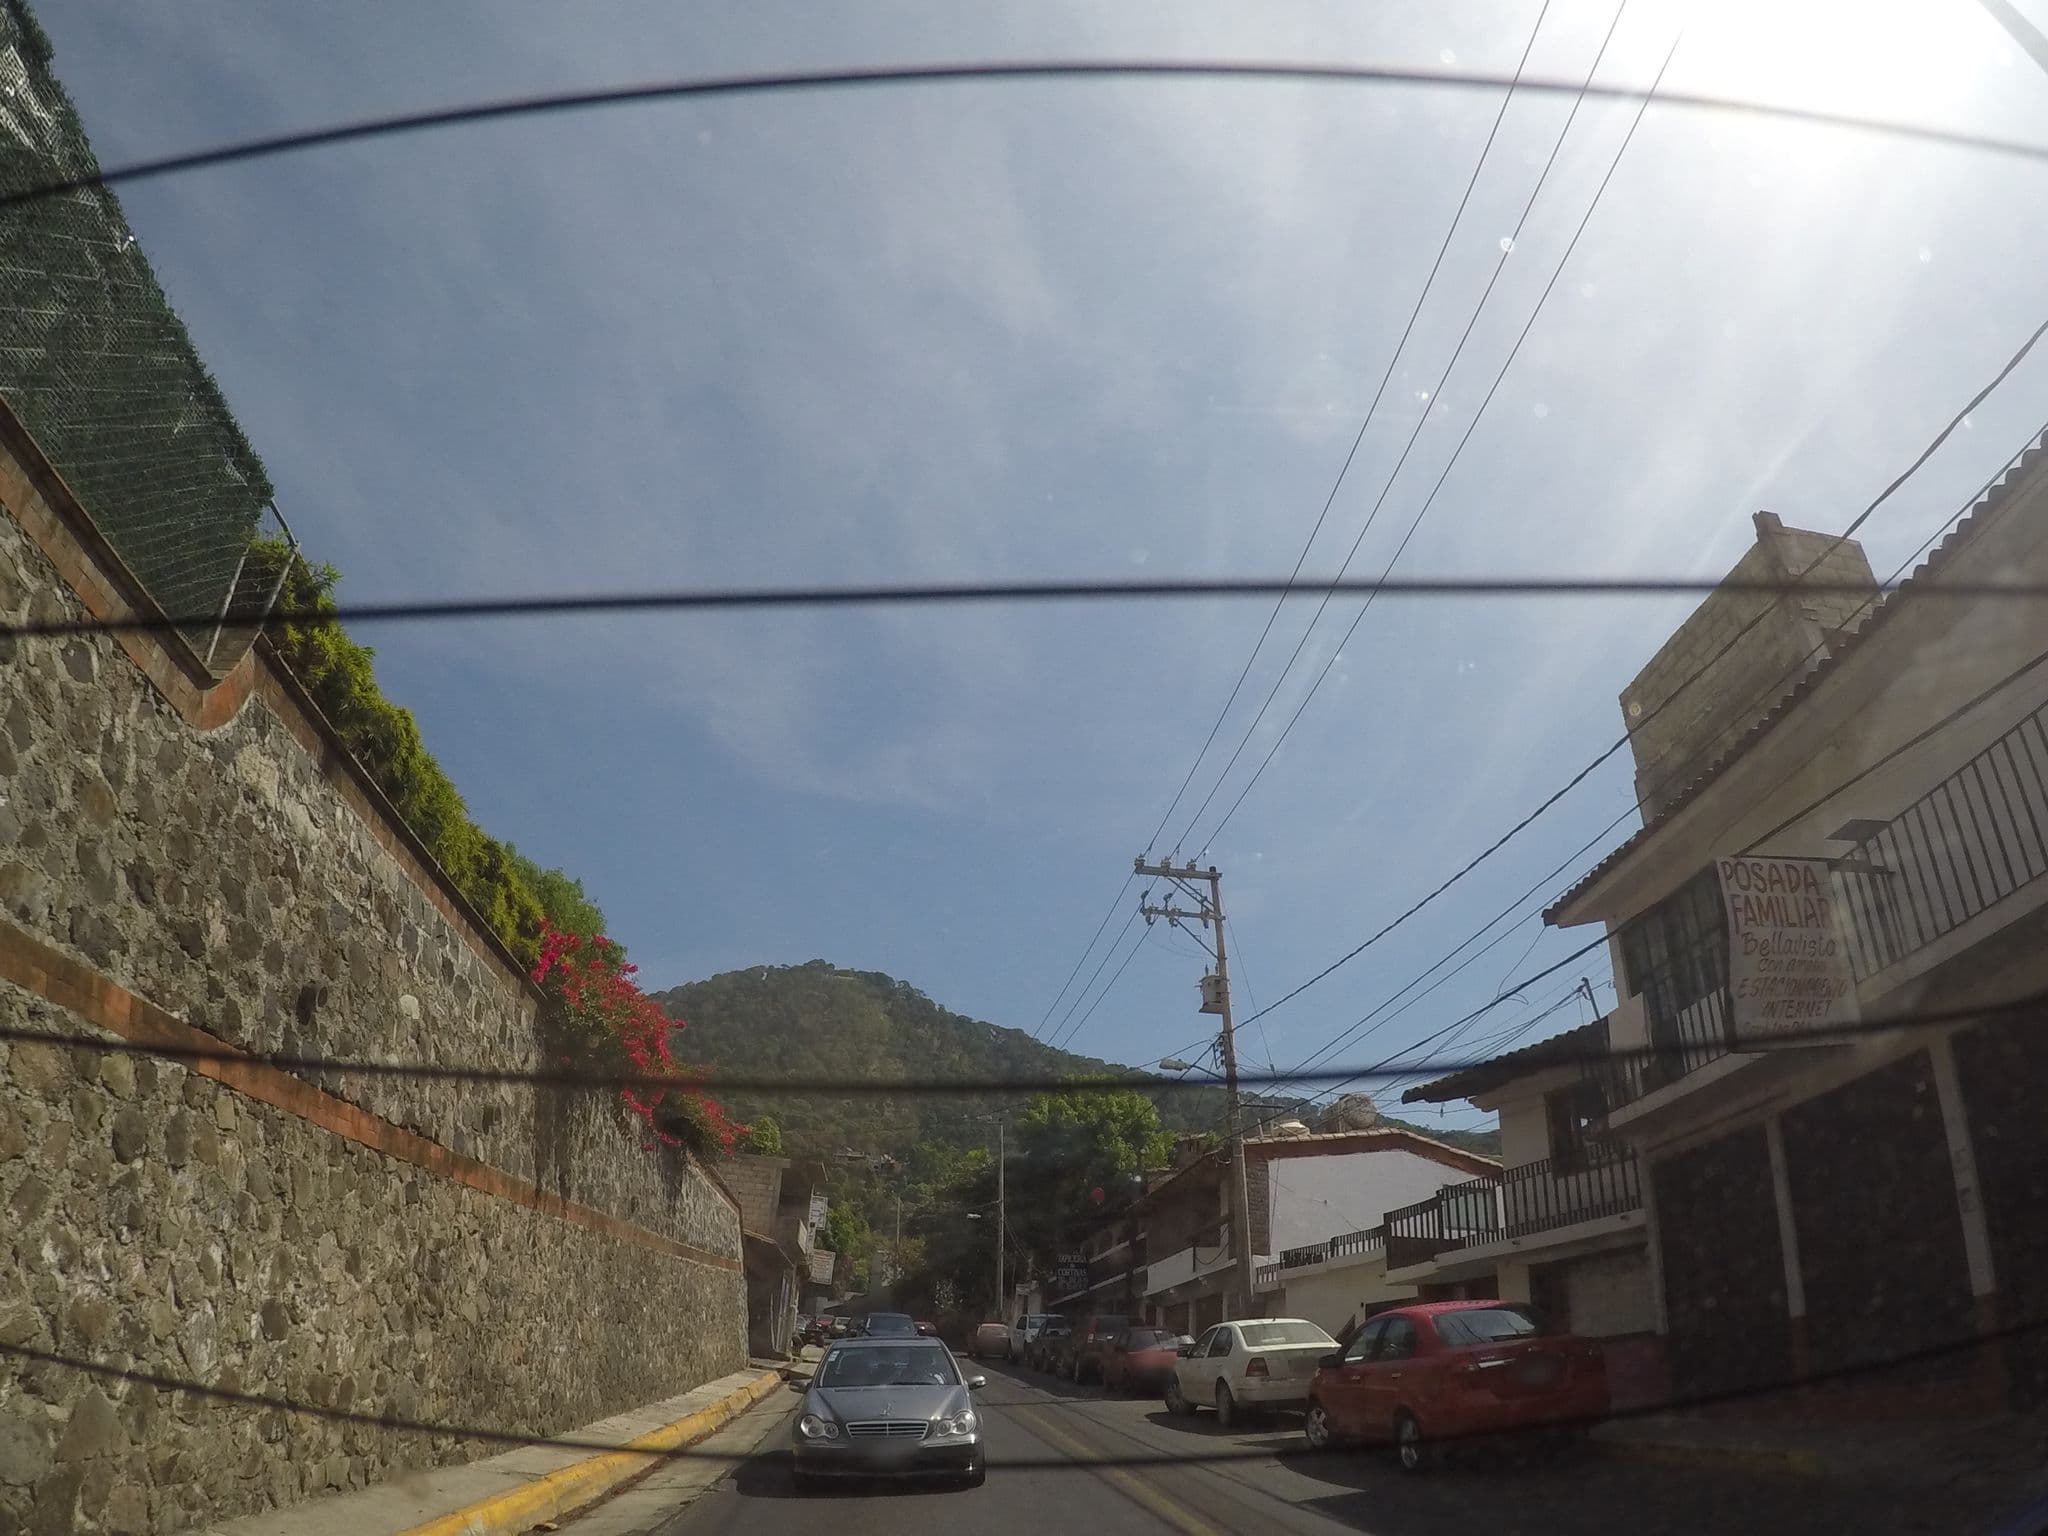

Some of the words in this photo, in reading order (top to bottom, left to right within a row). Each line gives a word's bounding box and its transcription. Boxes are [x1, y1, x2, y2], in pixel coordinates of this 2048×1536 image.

[1720, 861, 1820, 896] POSADA
[1730, 894, 1832, 934] FAMILIAR
[1760, 1000, 1832, 1018] INTERNET
